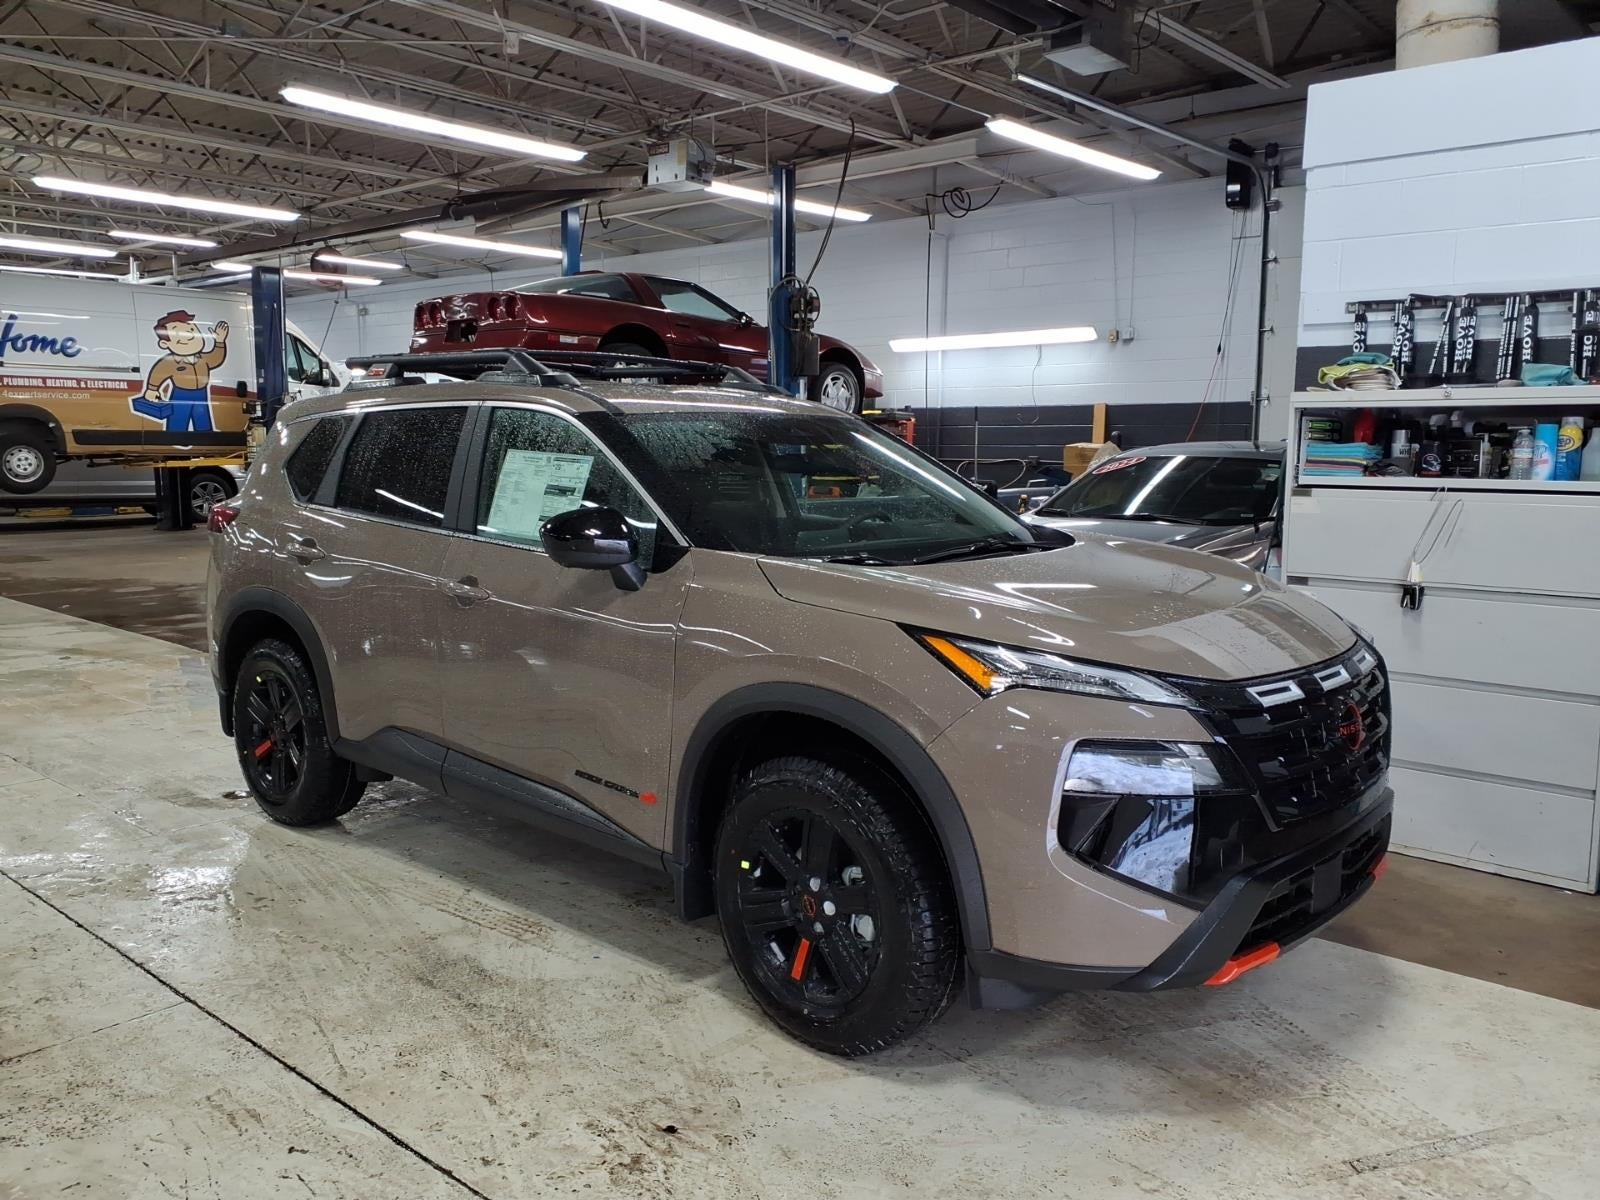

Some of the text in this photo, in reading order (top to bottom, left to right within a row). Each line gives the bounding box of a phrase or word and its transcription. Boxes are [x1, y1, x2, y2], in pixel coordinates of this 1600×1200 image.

[1353, 322, 1361, 352] OVE
[1391, 314, 1409, 357] HOVE
[1455, 317, 1467, 361] HOVE
[1522, 315, 1532, 360] HOVE
[1583, 310, 1594, 357] HOE
[4, 377, 45, 387] PLUMBING,
[46, 379, 79, 389] HEATING,
[88, 380, 128, 389] ELECTRICAL
[1558, 437, 1571, 448] ep
[1339, 724, 1360, 736] NISS
